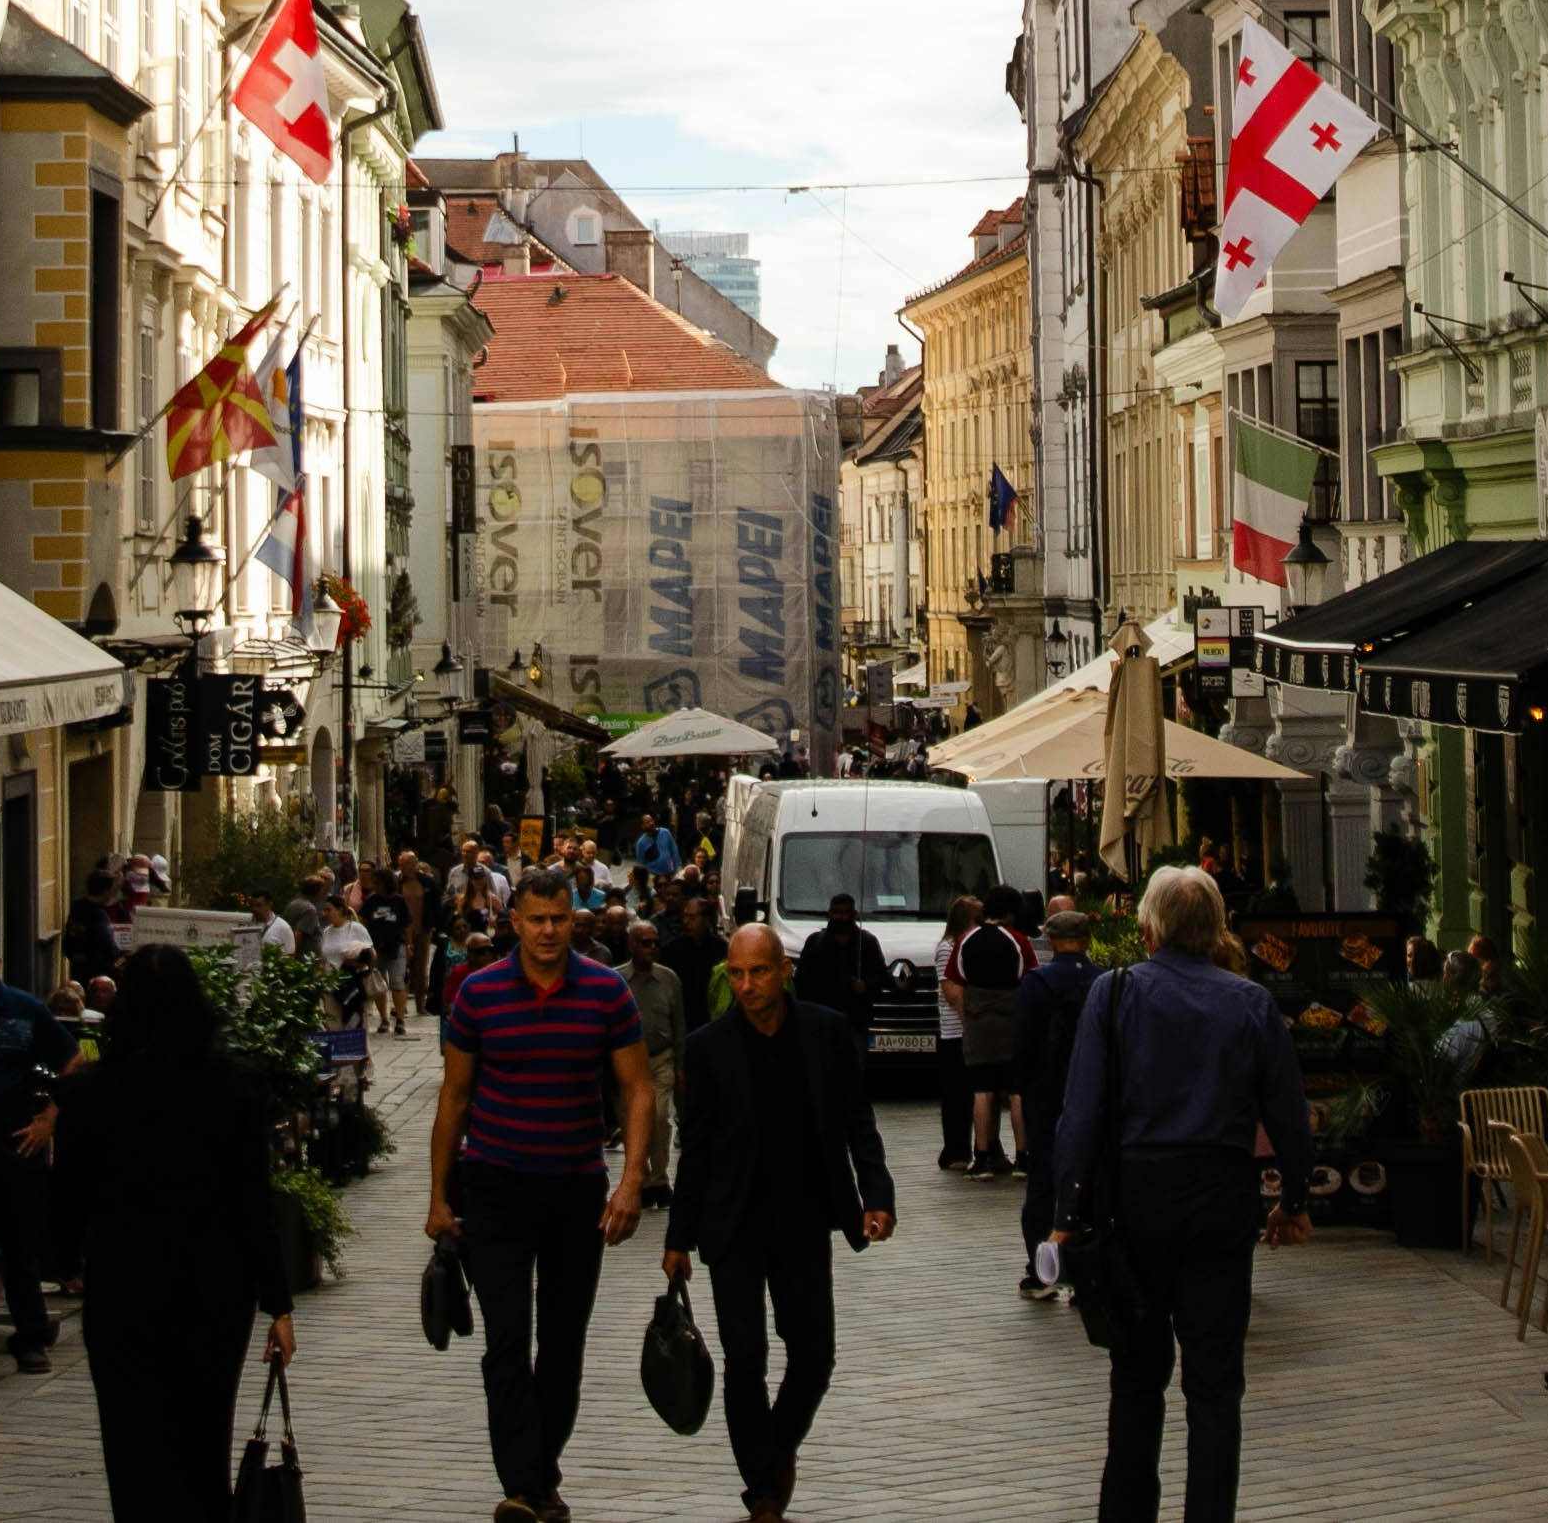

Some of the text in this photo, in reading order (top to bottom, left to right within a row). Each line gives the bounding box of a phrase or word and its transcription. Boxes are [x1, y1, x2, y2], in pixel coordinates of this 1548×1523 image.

[648, 495, 693, 657] MAPEI
[737, 506, 785, 686] MAPEI
[813, 491, 835, 651] MAPEI
[208, 733, 223, 773] DOM
[226, 677, 255, 774] CIGÁR
